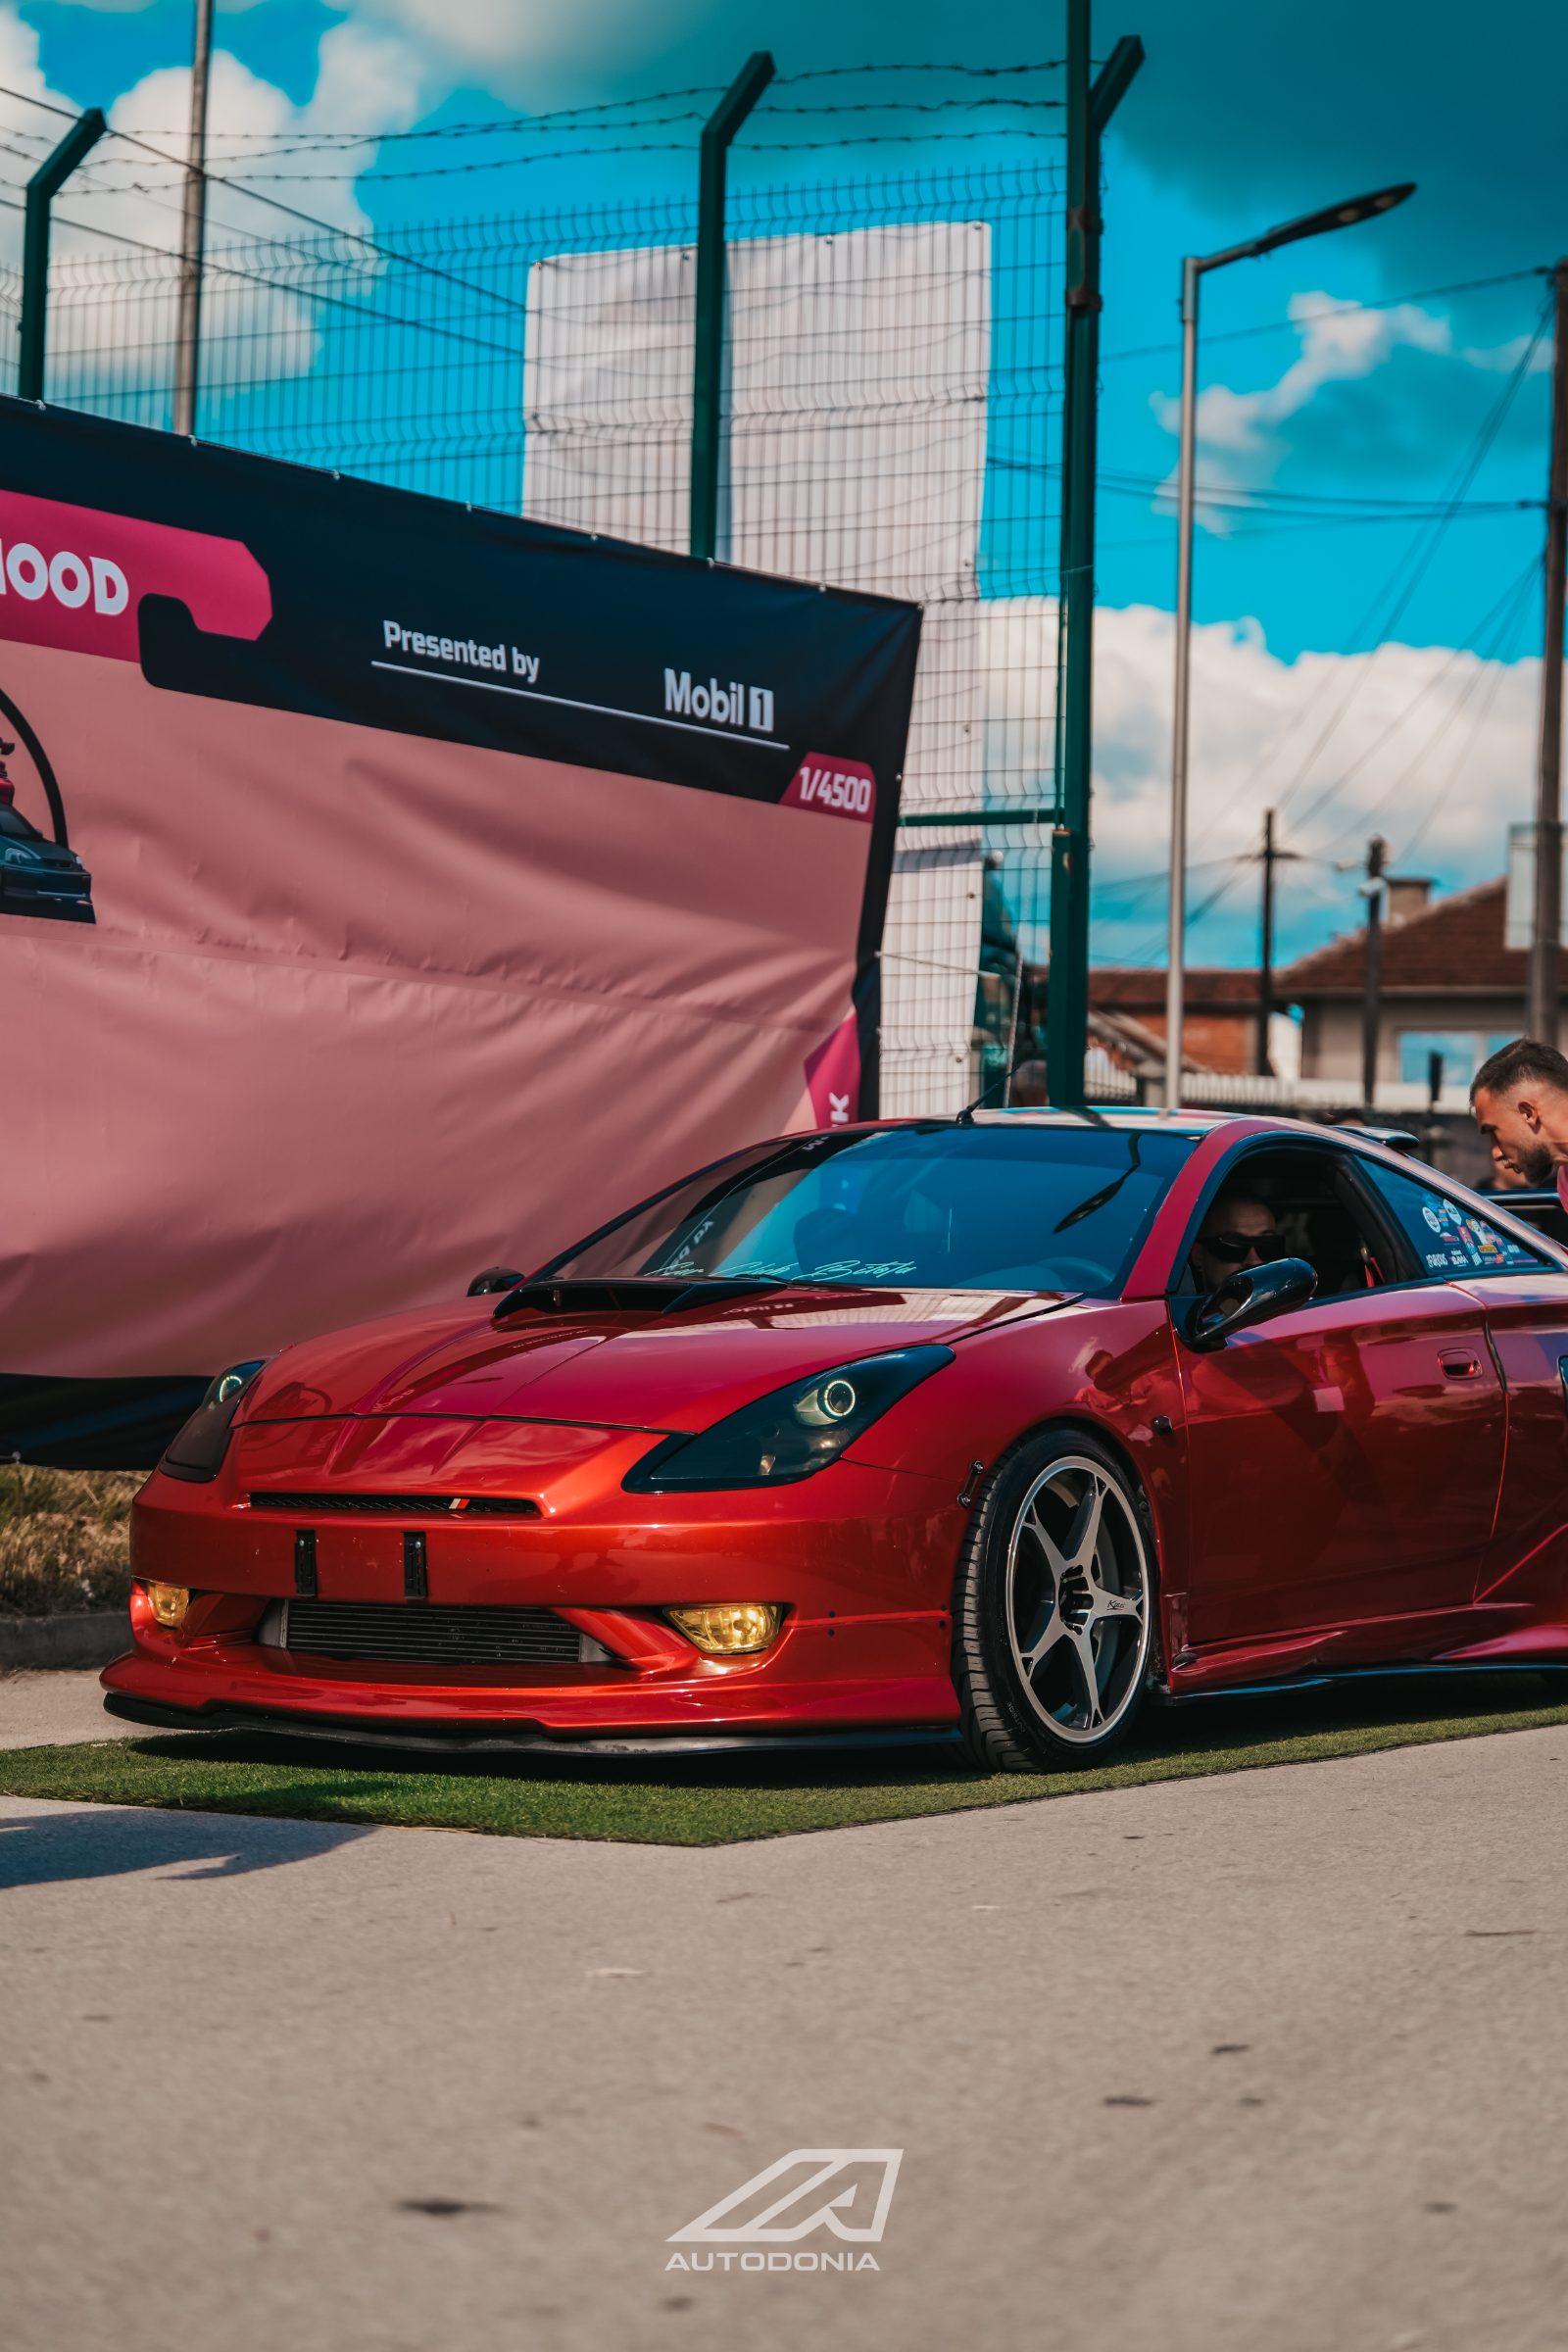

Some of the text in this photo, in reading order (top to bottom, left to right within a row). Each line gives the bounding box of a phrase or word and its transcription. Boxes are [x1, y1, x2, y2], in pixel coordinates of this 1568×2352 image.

[0, 539, 129, 615] OOD
[383, 619, 540, 684] Presented by
[664, 667, 745, 726] Mobil
[800, 766, 872, 813] 1/4500
